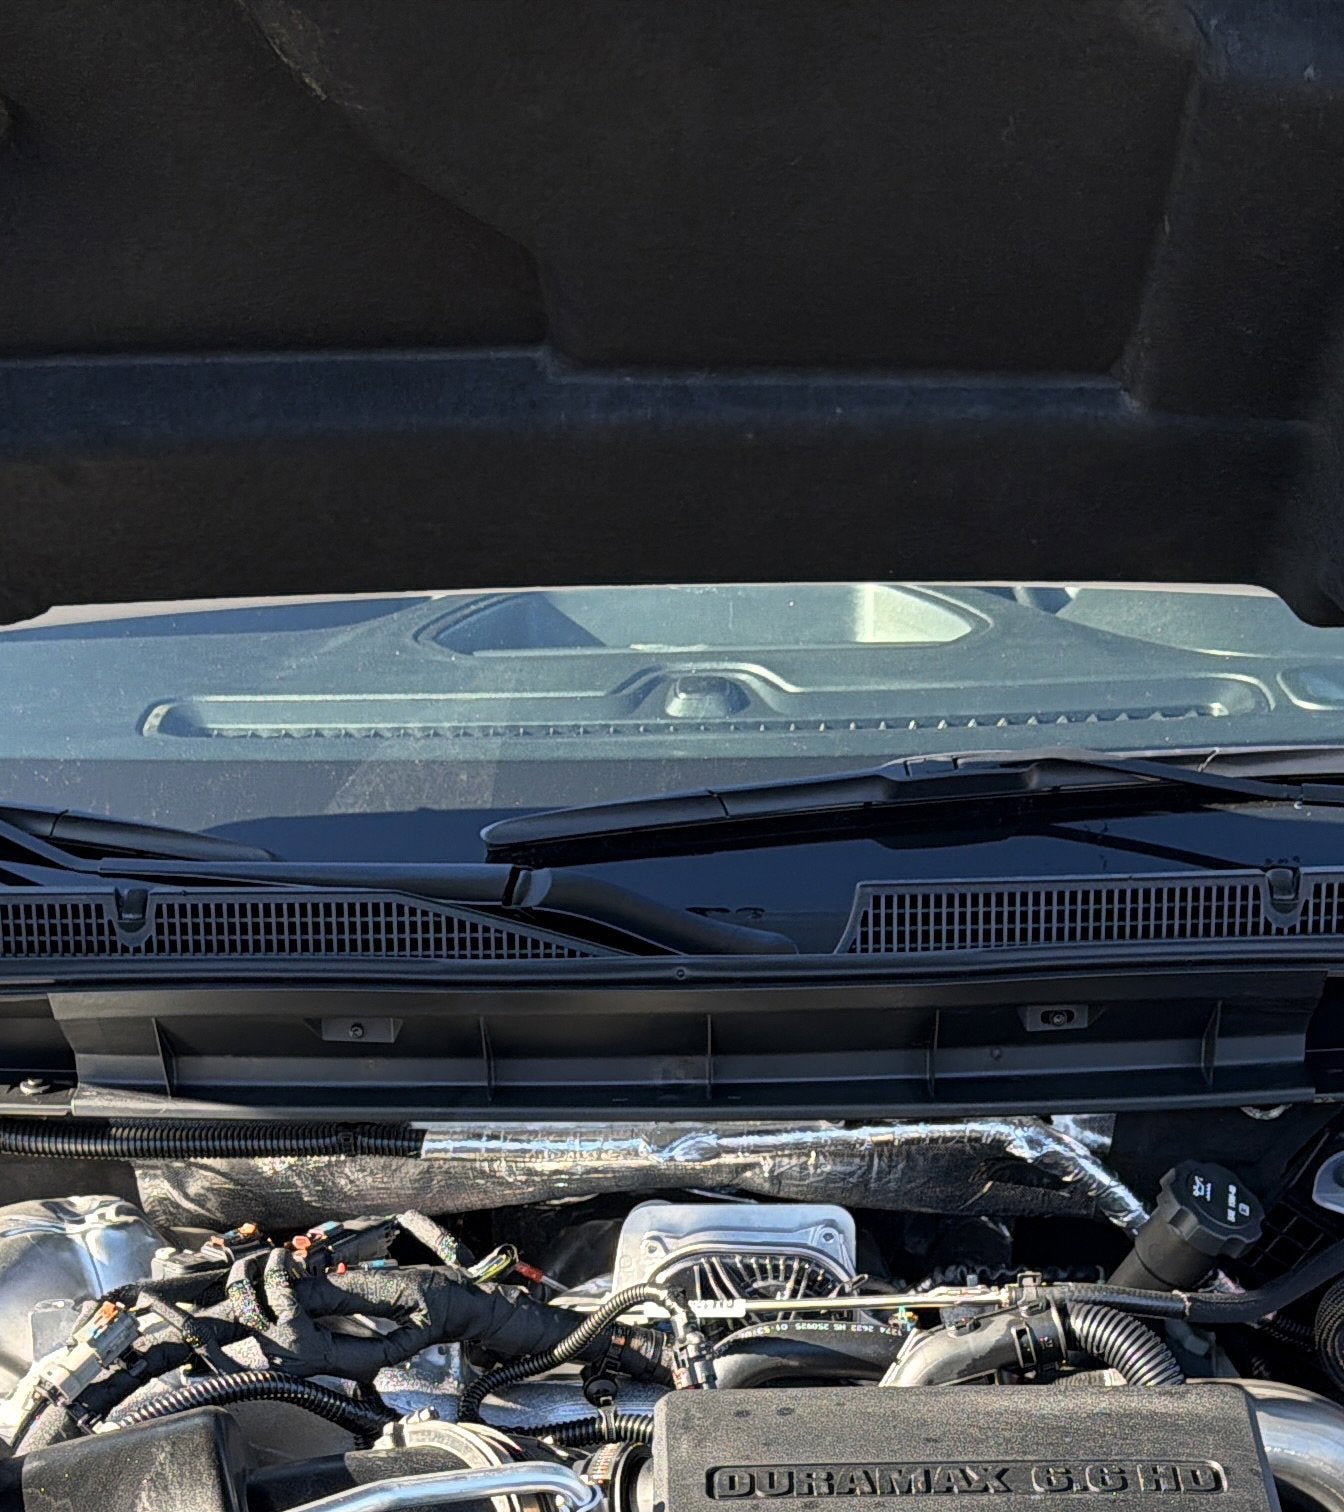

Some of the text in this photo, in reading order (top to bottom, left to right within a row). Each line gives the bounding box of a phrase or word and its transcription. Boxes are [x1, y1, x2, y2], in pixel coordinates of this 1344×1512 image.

[717, 1461, 1222, 1496] DURAMAX 6.6 HD
